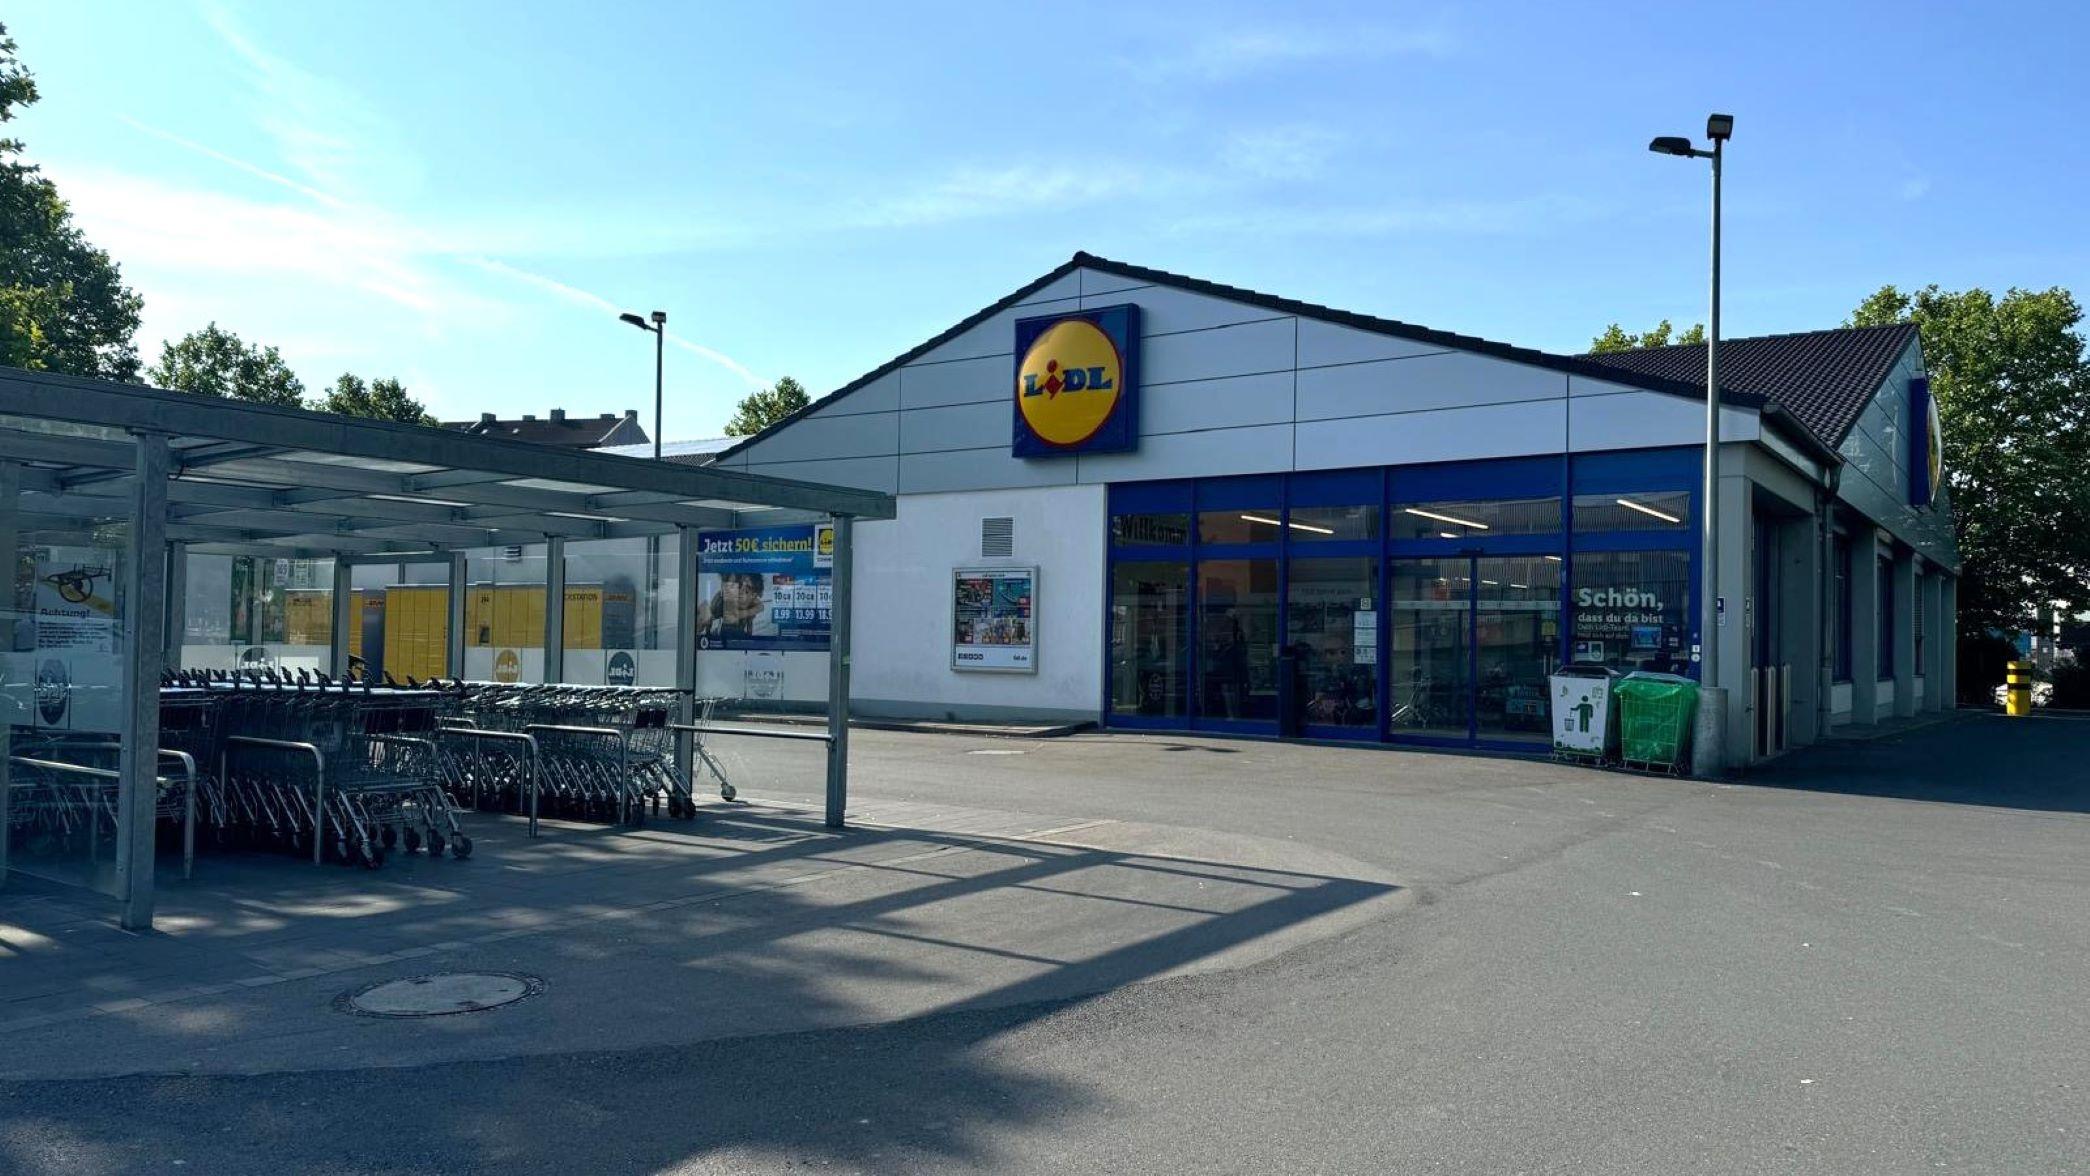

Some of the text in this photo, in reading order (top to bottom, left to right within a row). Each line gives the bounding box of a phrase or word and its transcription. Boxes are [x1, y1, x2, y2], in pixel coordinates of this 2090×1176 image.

[704, 538, 733, 553] Jetzt
[735, 537, 759, 553] 50€
[762, 535, 812, 552] sichern!
[1577, 586, 1665, 611] Schön,
[40, 607, 91, 620] Achtung!
[1578, 612, 1665, 624] dass du da bist
